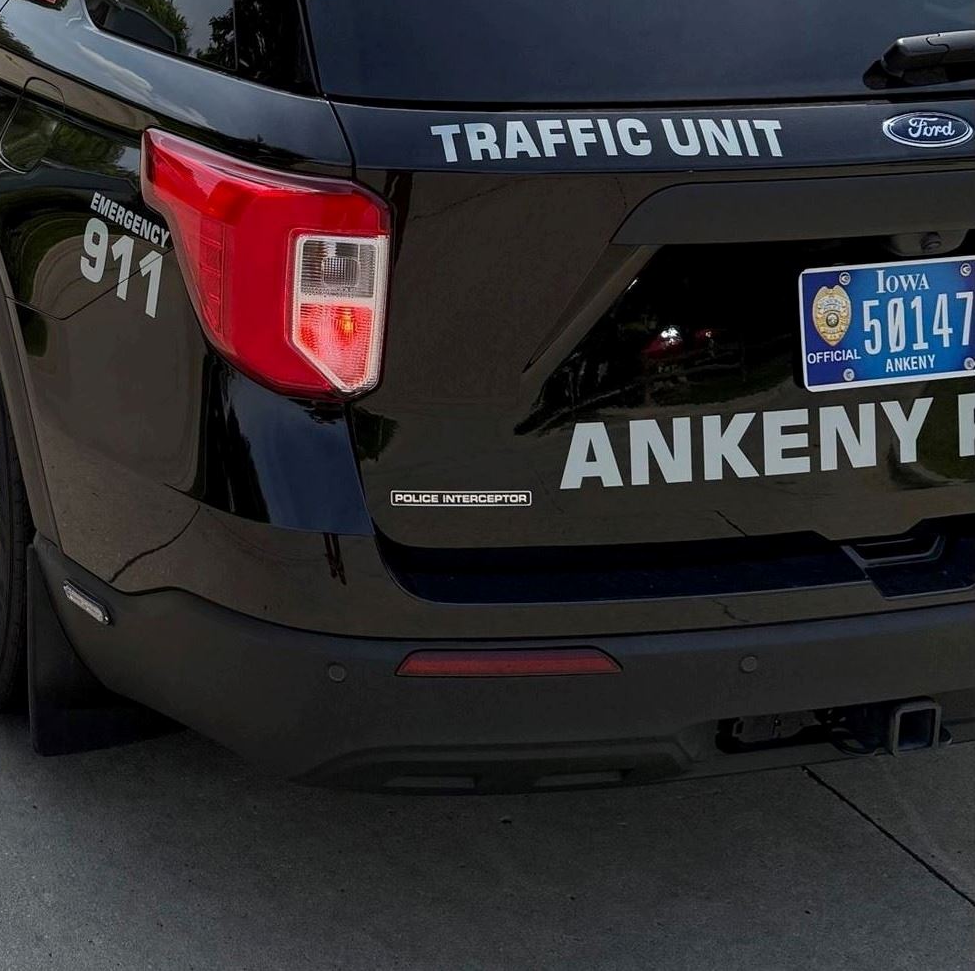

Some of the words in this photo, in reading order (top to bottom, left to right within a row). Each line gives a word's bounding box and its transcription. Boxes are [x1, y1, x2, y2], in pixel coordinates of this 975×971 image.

[430, 118, 653, 163] TRAFFIC
[661, 118, 784, 158] UNIT
[908, 117, 956, 138] Ford
[90, 192, 170, 248] EMERGENCY
[80, 217, 163, 319] 911
[862, 291, 974, 355] 50147
[807, 349, 862, 364] OFFICIAL
[885, 354, 936, 373] ANKENY
[560, 397, 934, 489] ANKENY
[395, 494, 438, 503] POLICE
[443, 494, 527, 503] INTERCEPTOR
